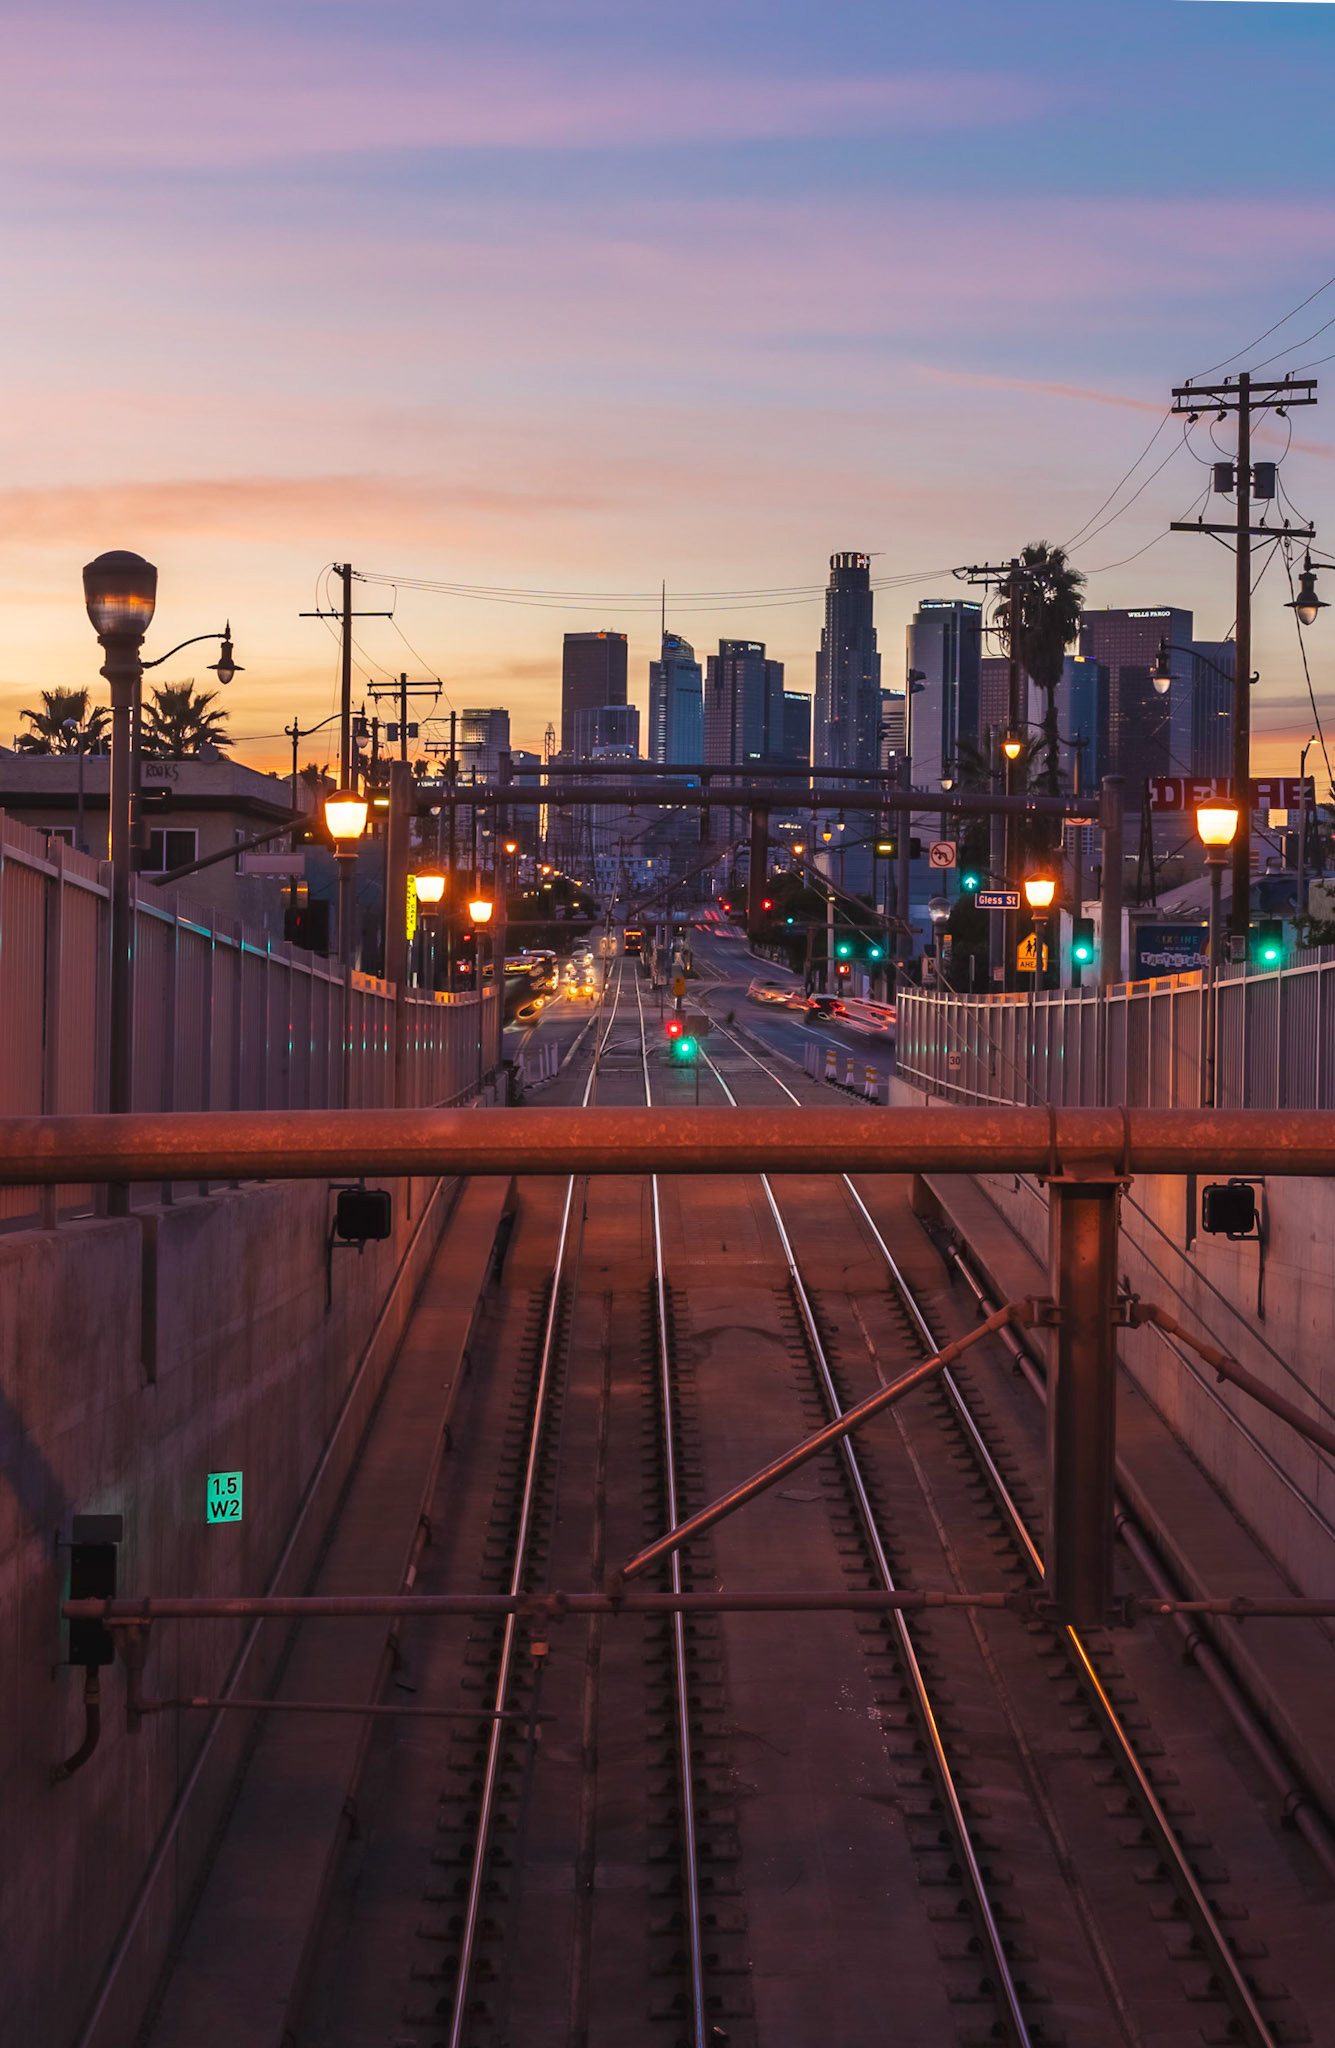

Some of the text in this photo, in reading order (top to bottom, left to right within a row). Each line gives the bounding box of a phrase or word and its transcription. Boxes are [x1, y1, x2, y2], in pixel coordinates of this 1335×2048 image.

[979, 895, 1016, 905] Gless St
[949, 1056, 960, 1065] 30
[212, 1477, 237, 1495] 1.5
[210, 1499, 240, 1518] W2
